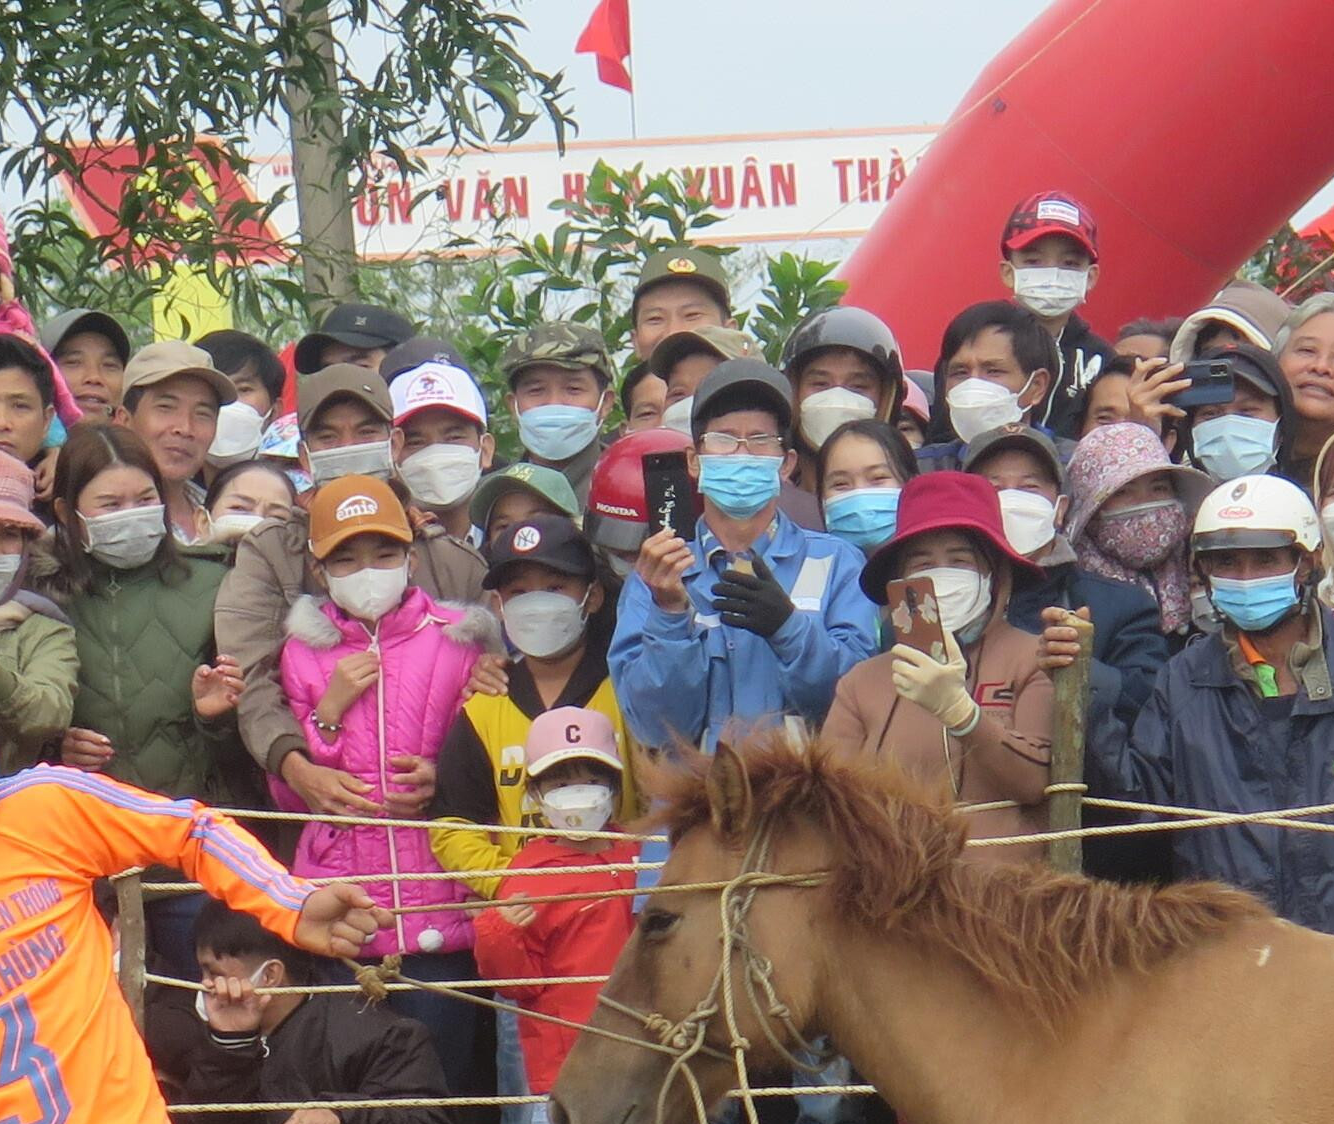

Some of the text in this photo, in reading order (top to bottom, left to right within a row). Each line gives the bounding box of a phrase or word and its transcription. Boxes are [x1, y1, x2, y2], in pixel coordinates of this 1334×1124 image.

[444, 169, 529, 222] VĂN
[682, 156, 798, 209] XUÂN
[832, 146, 909, 203] THÀ
[596, 502, 639, 517] HONDA
[565, 724, 581, 743] C
